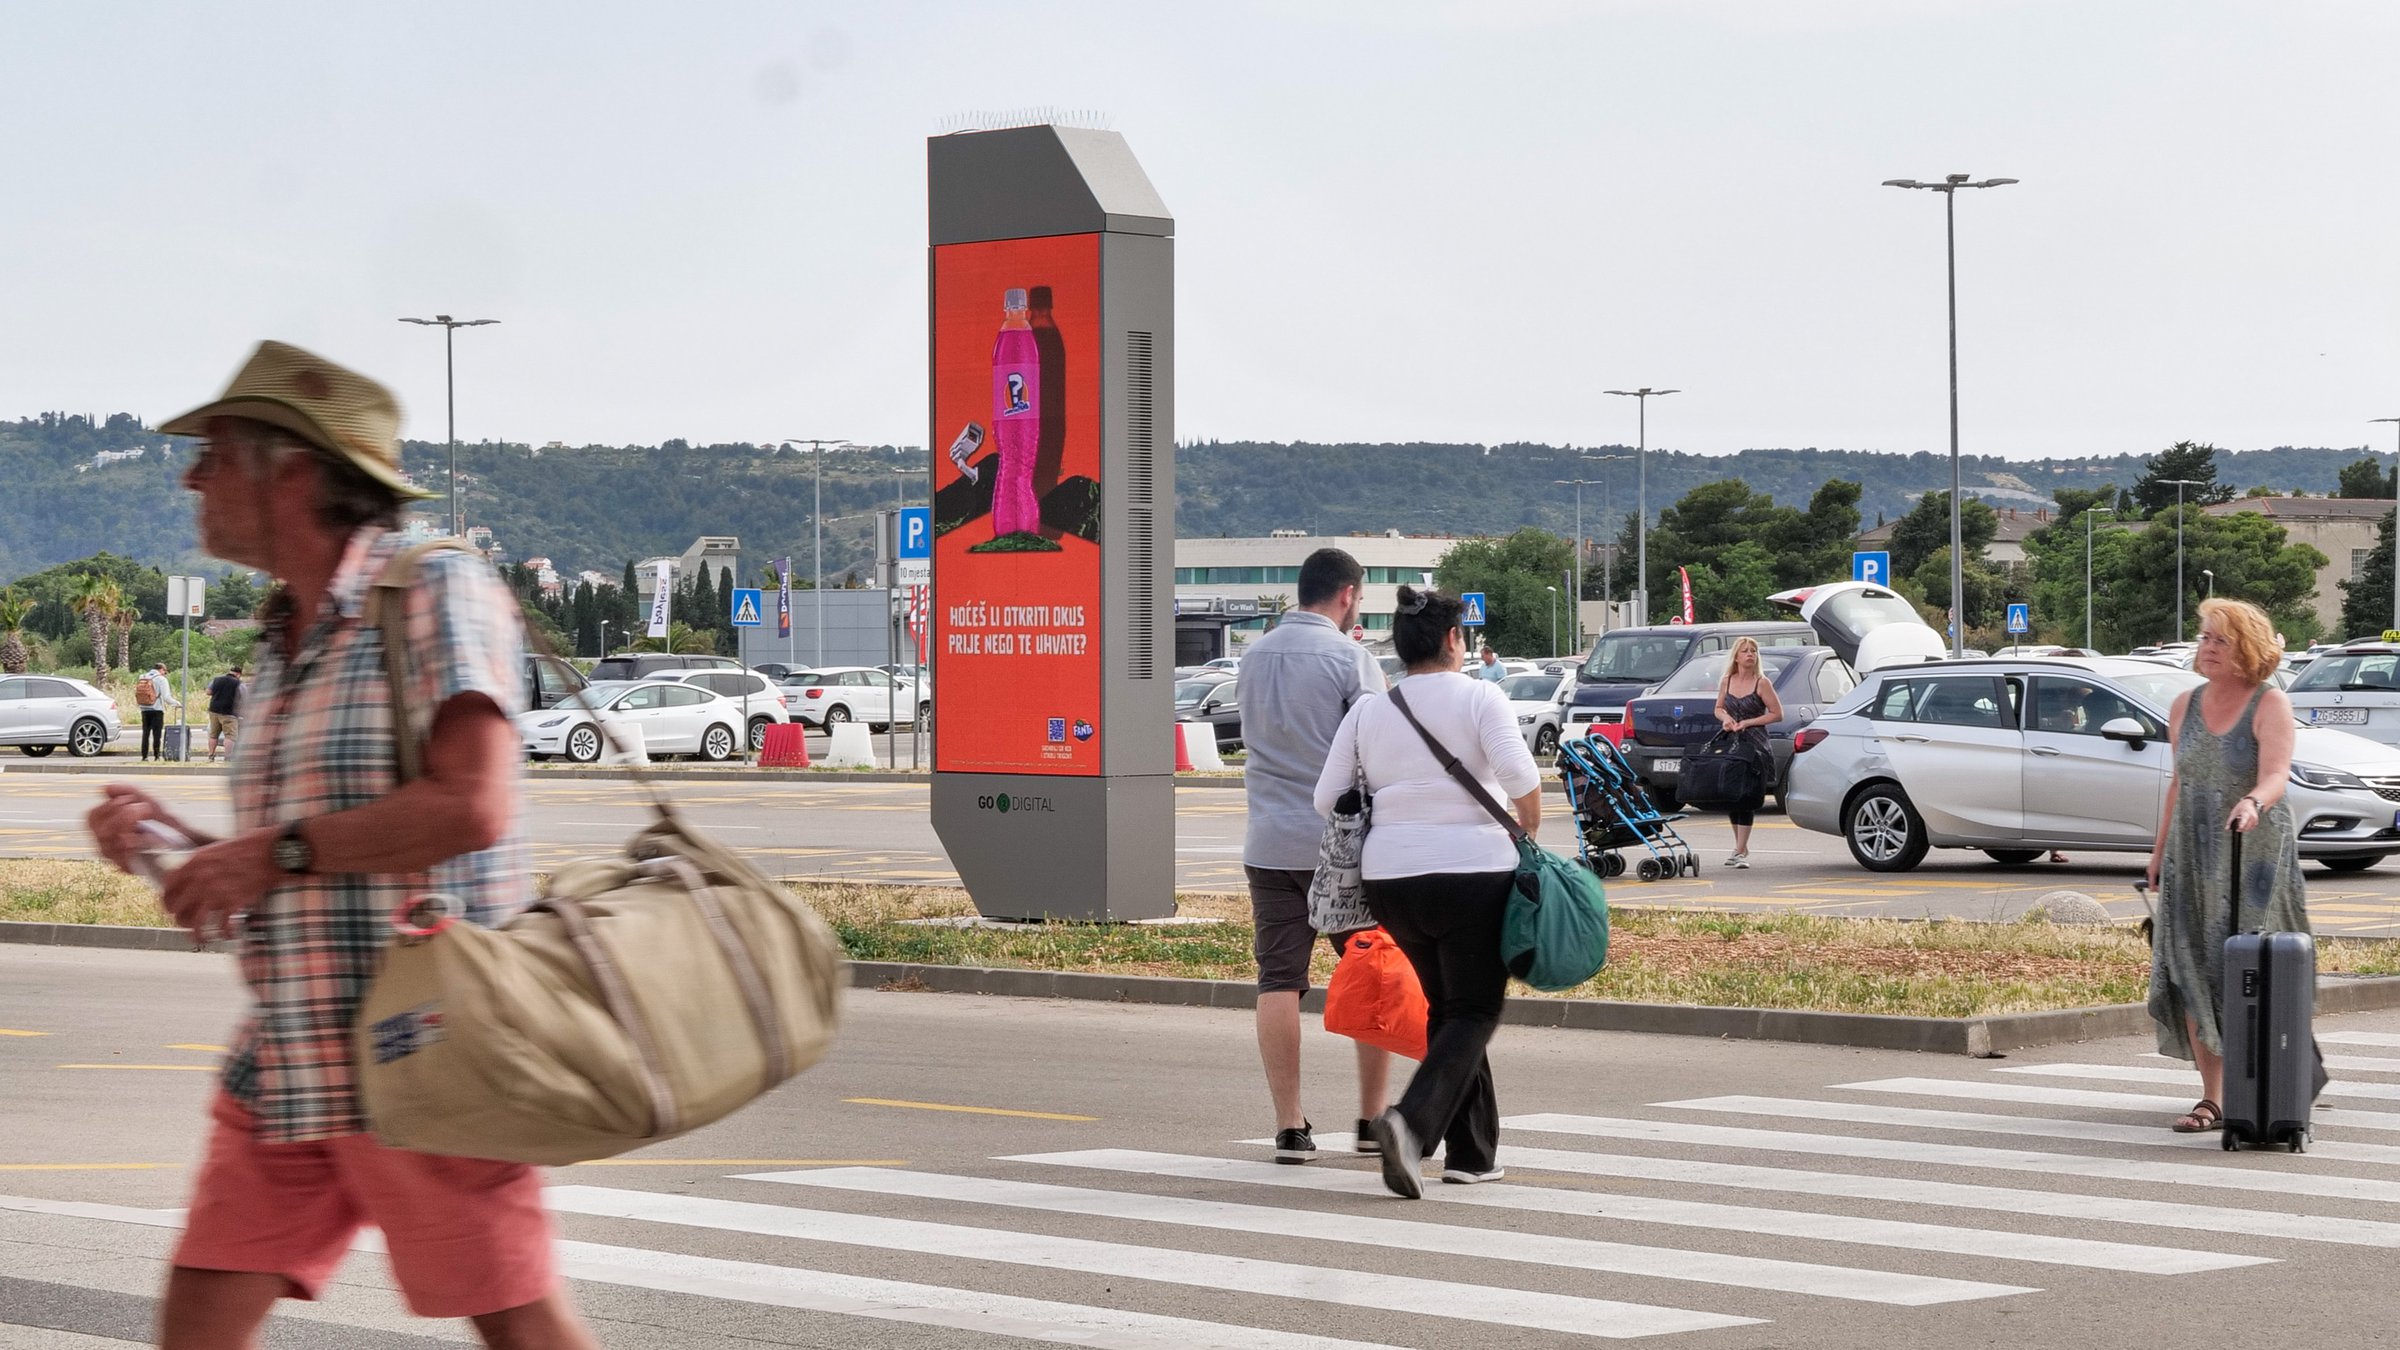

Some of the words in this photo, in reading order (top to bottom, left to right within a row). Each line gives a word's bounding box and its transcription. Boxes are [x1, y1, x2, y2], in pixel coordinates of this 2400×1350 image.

[908, 516, 924, 549] P
[900, 567, 908, 578] 10
[909, 567, 930, 581] mjesta
[1863, 559, 1879, 582] P
[949, 600, 986, 627] HOĆEŠ
[990, 606, 1000, 626] LI
[1003, 606, 1049, 627] OTKRITI
[1053, 606, 1085, 627] OKUS
[1229, 603, 1240, 611] Car
[1240, 603, 1255, 611] Wash
[948, 634, 981, 654] PRIJE
[984, 634, 1014, 654] NEGO
[1017, 634, 1032, 654] TE
[1036, 634, 1087, 655] UHVATE?
[2317, 711, 2328, 721] ZG
[978, 796, 994, 809] GO
[1012, 797, 1055, 811] DIGITAL
